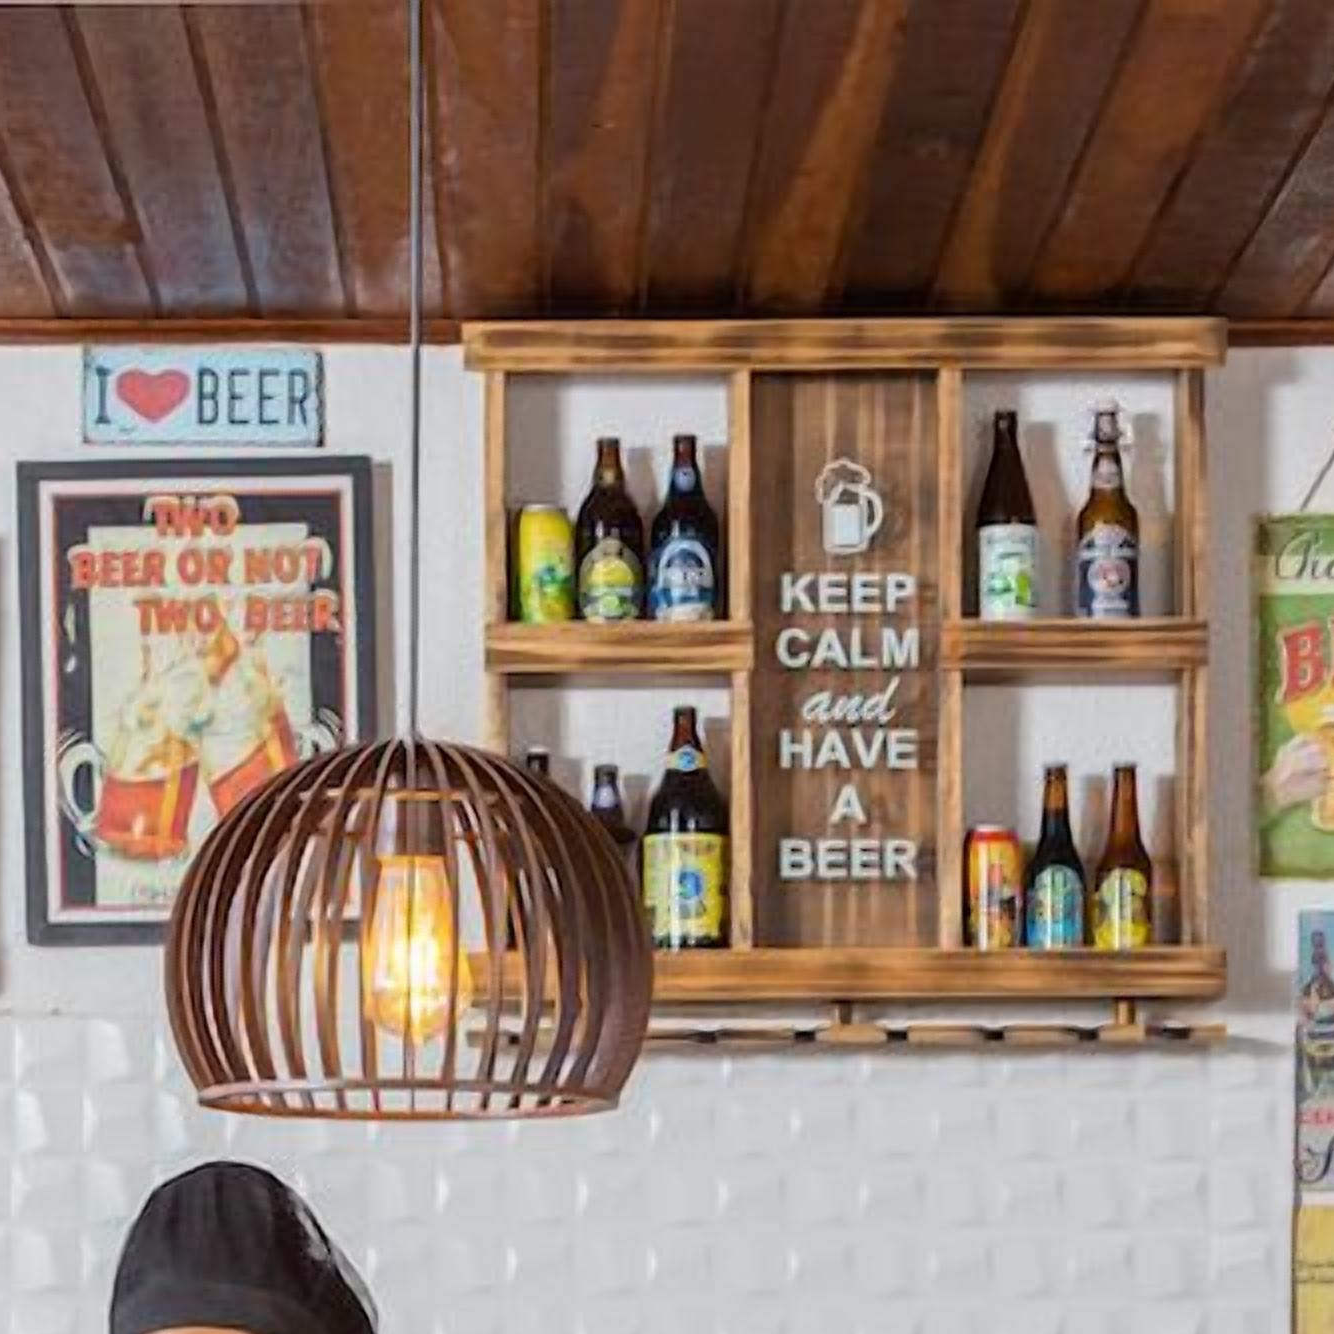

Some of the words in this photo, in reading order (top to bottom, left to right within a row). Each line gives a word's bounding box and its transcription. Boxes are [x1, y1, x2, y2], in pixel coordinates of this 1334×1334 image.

[95, 366, 112, 425] I
[196, 367, 309, 426] BEER
[150, 499, 239, 538] TWO
[70, 549, 167, 589] BEER
[177, 548, 233, 586] OR
[244, 547, 324, 584] NOT
[779, 571, 917, 614] KEEP
[134, 597, 221, 635] TWO
[243, 596, 341, 634] BEER
[775, 625, 920, 669] CALM
[800, 675, 901, 723] and
[778, 727, 919, 770] HAVE
[829, 784, 868, 825] A
[778, 837, 919, 880] BEER
